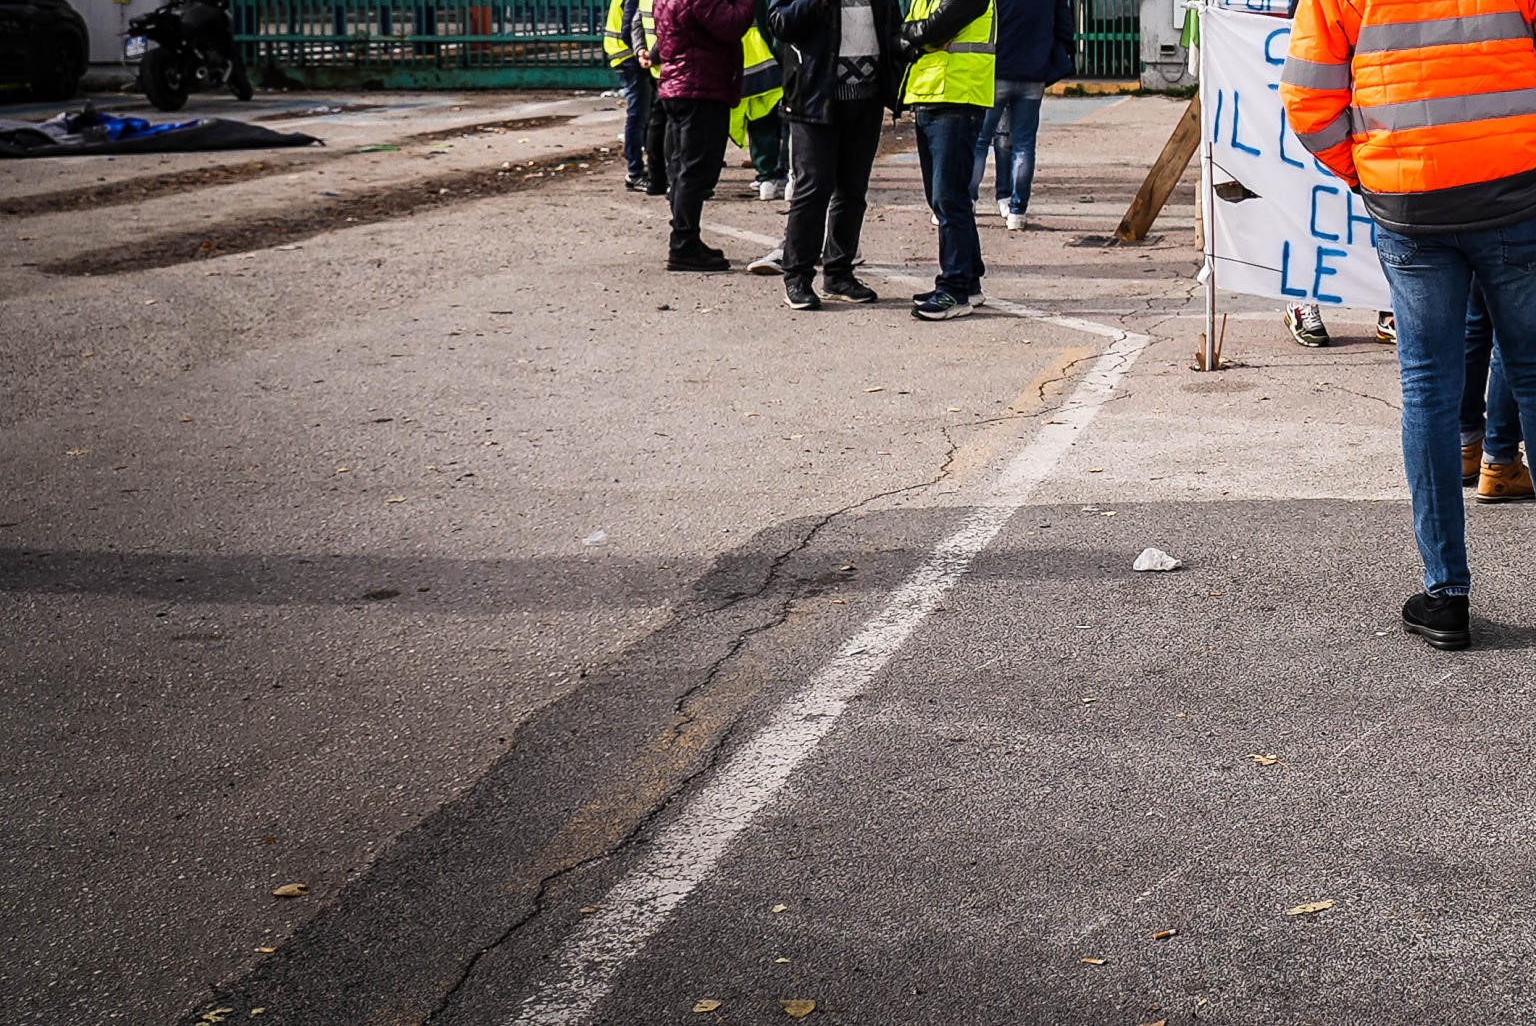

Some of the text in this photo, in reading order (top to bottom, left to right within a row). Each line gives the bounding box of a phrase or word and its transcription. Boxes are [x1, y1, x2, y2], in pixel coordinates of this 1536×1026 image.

[1213, 88, 1262, 157] IL
[1309, 184, 1378, 246] CH
[1280, 239, 1349, 304] LE
